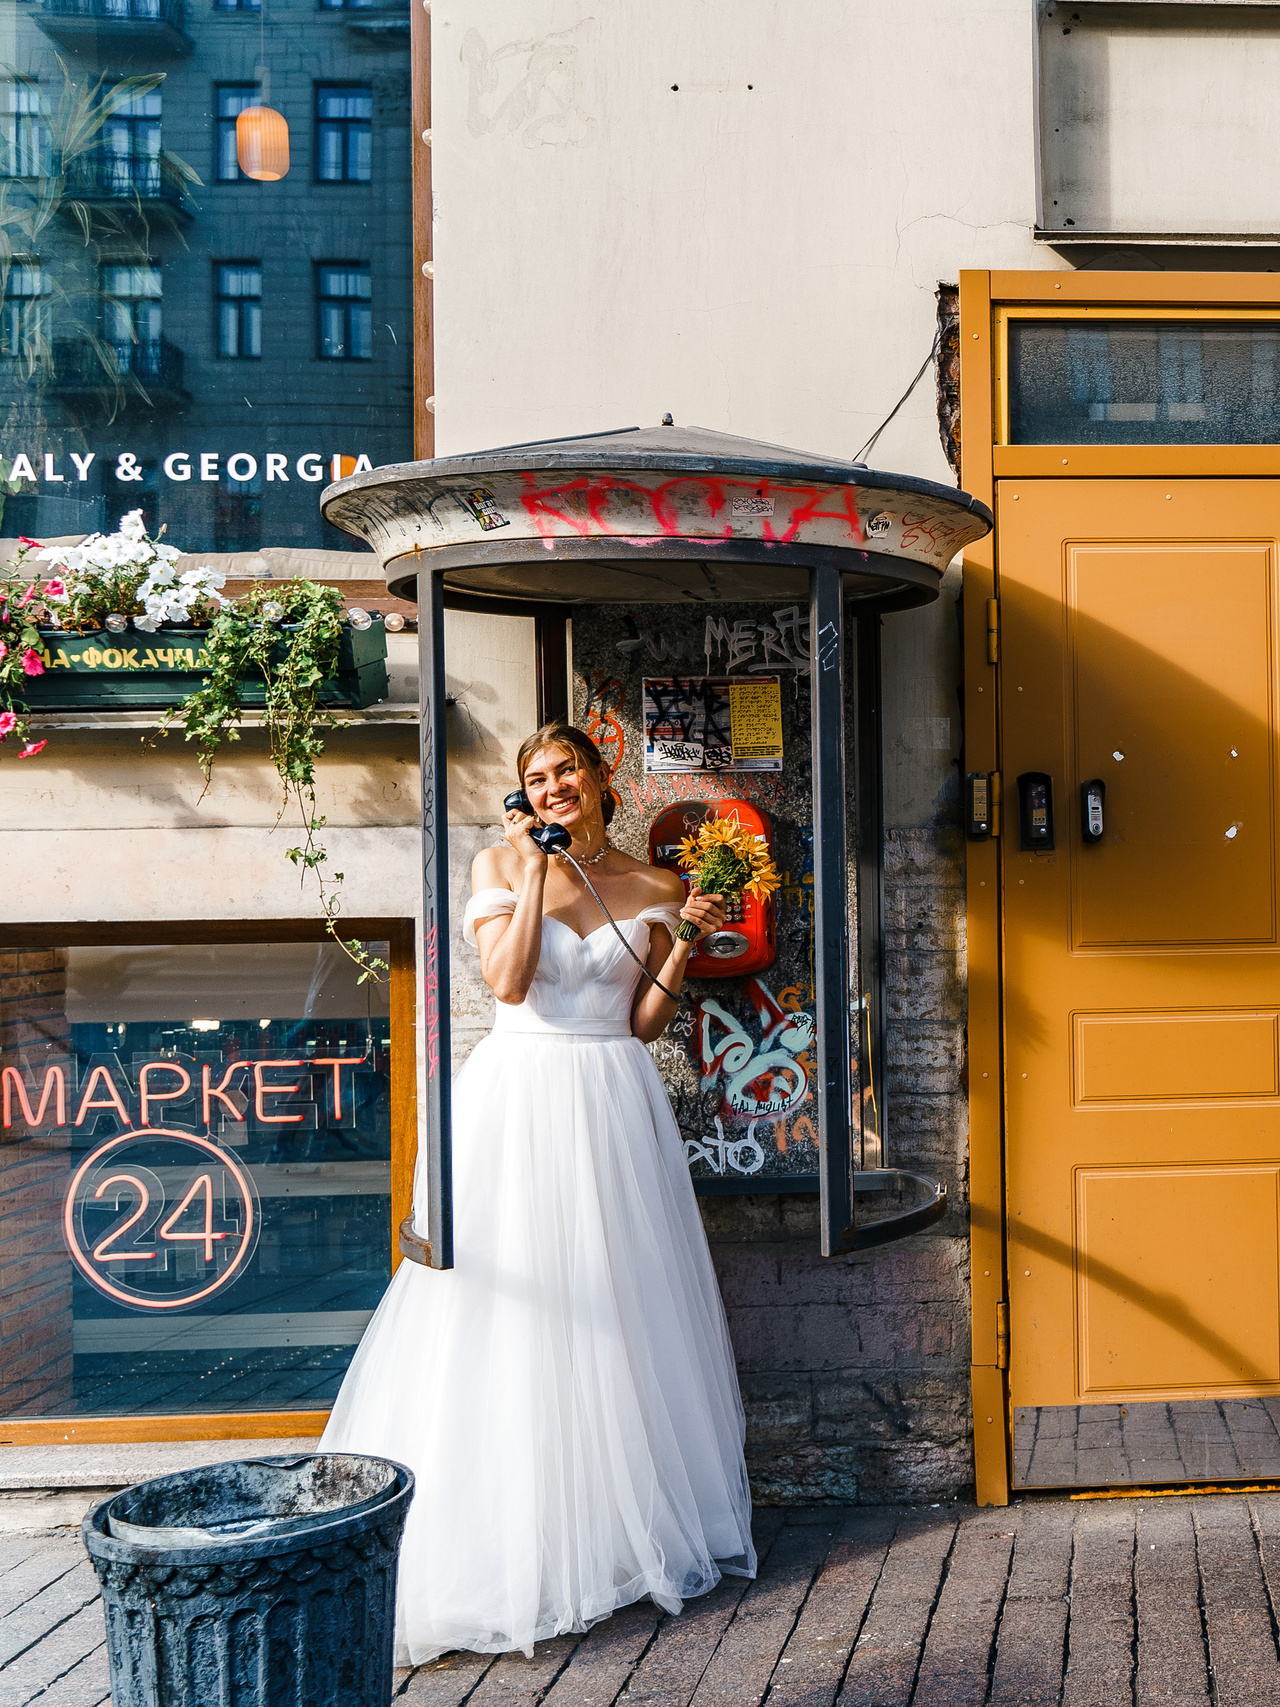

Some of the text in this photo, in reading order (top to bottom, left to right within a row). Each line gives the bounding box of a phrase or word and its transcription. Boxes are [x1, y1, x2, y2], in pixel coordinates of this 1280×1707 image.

[0, 452, 374, 482] ALY & GEORGIA
[1, 1057, 366, 1128] МАРКЕТ
[93, 1174, 227, 1262] 24
